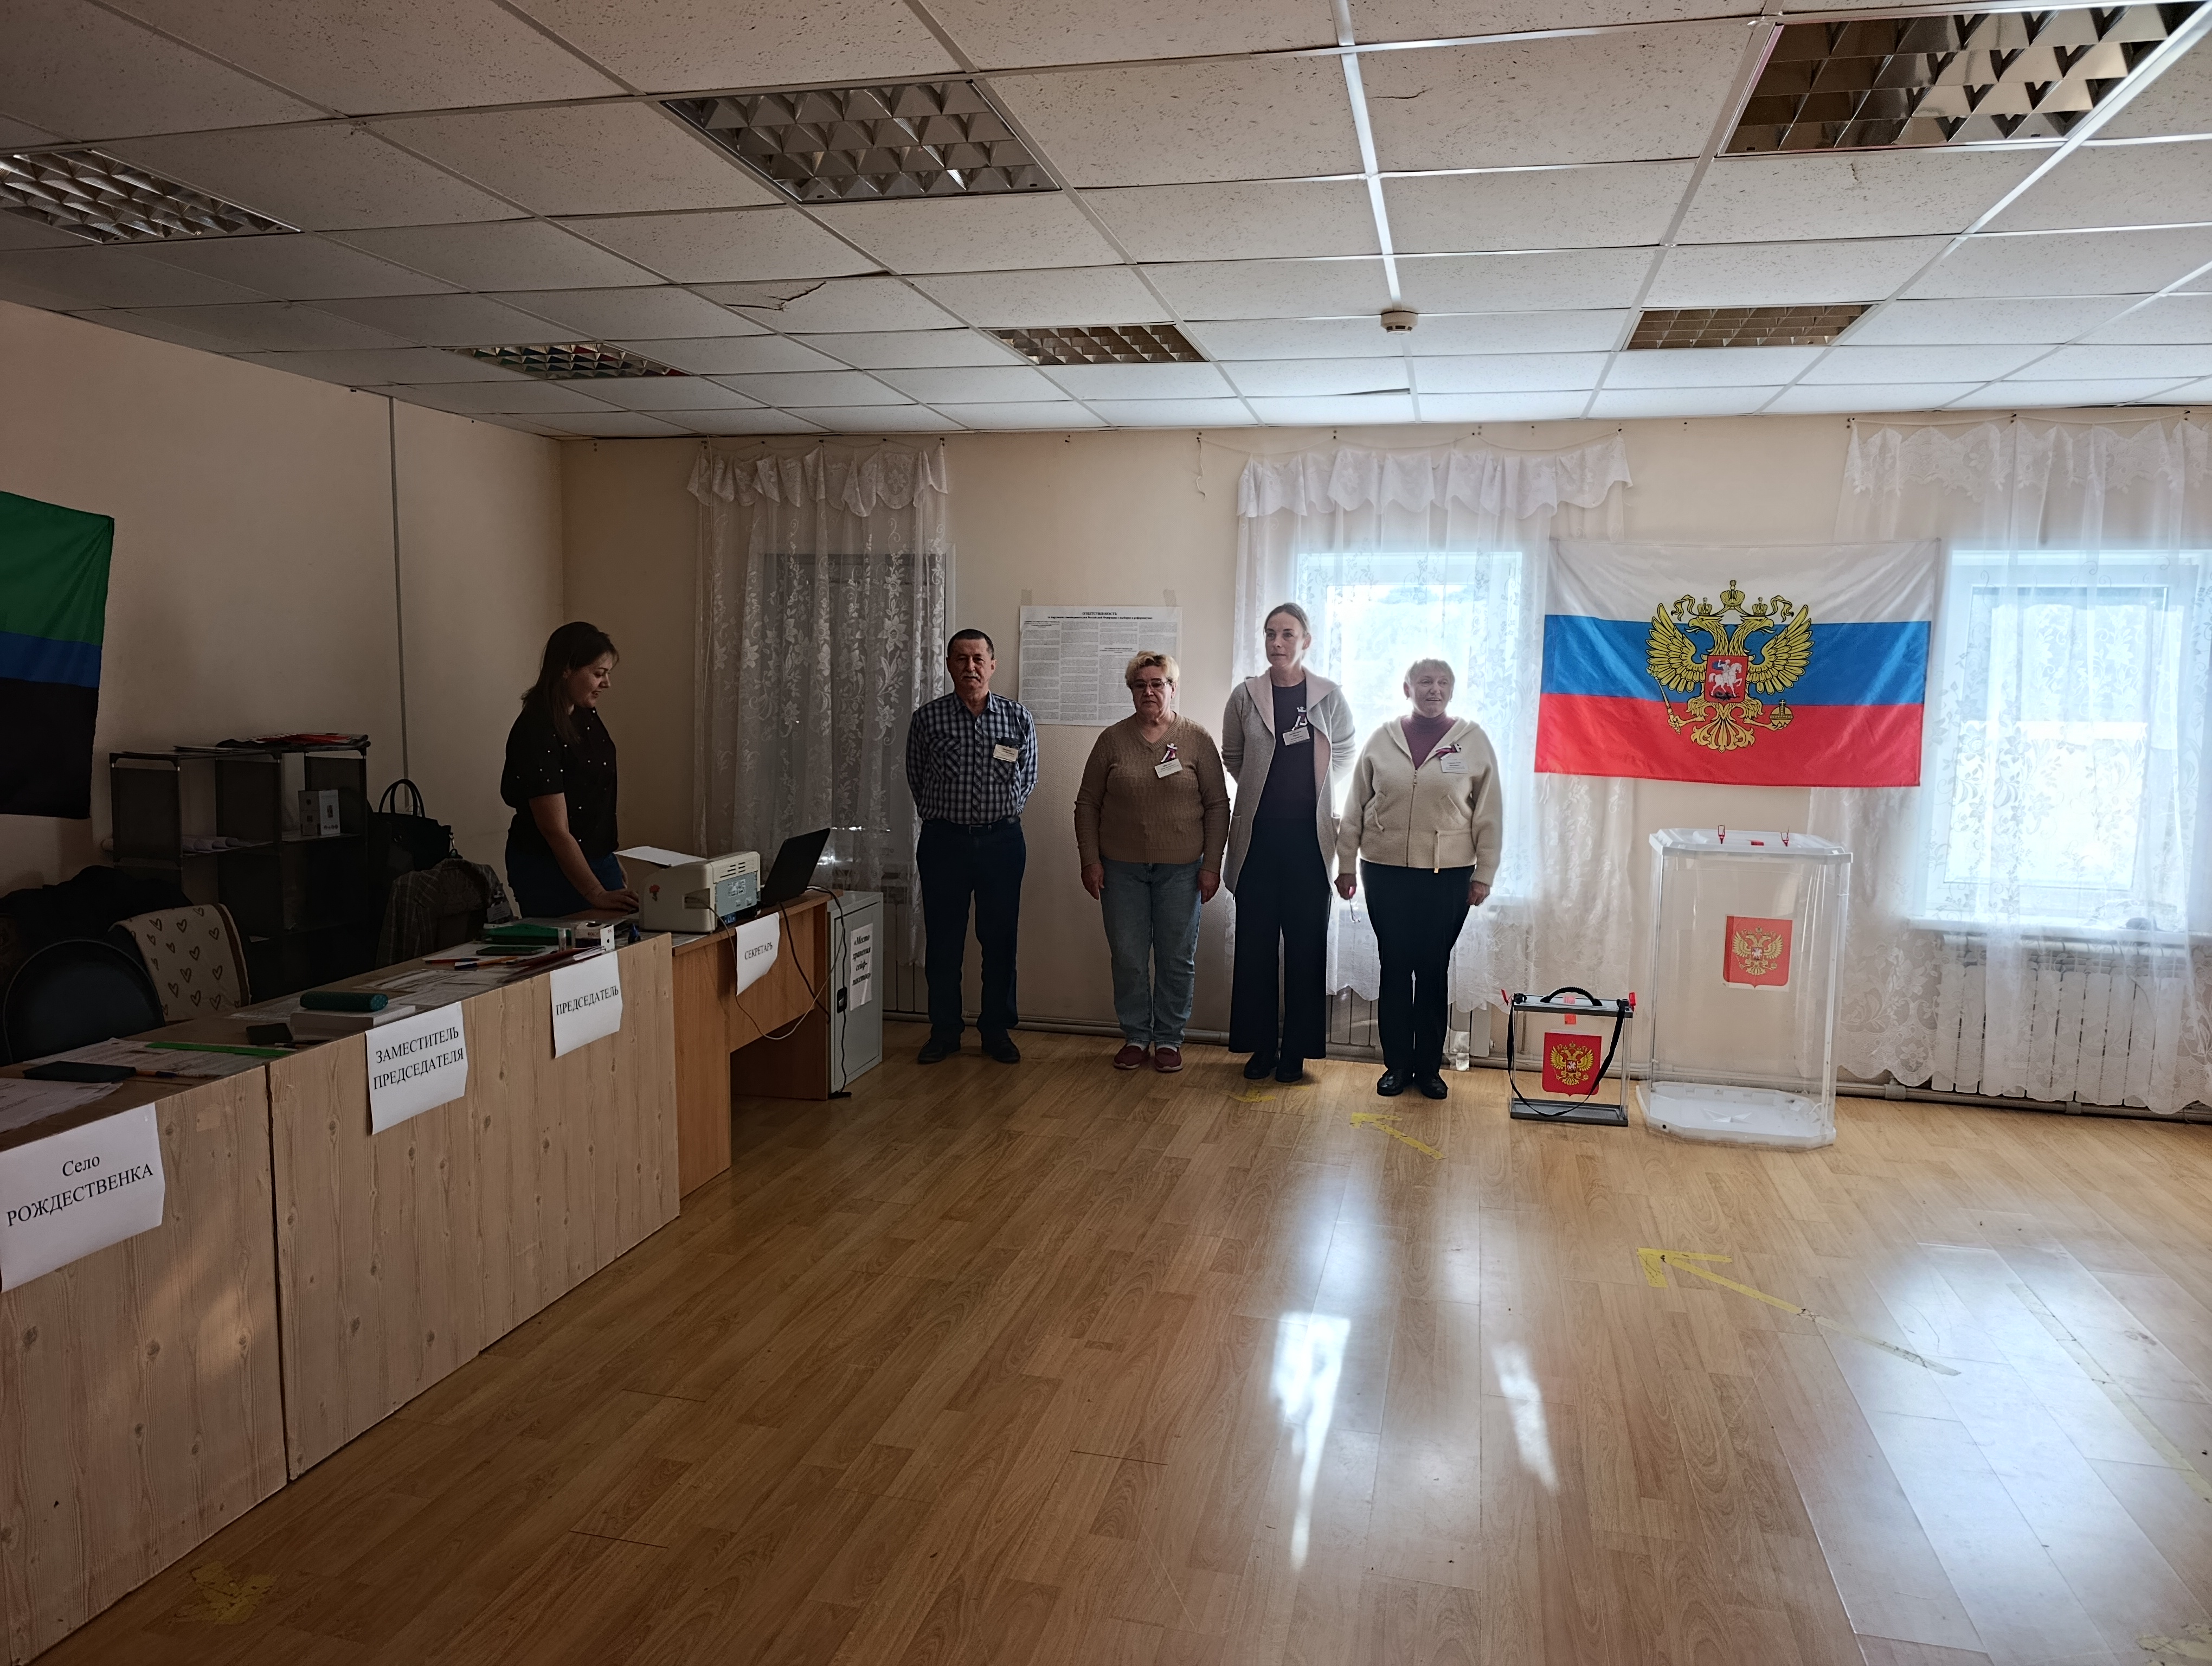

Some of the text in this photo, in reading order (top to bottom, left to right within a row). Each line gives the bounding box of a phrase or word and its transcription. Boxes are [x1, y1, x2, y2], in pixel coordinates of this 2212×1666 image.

[744, 942, 773, 960] СЕКРЕТАРЬ
[556, 985, 619, 1016] ПРЕДСЕДАТЕЛЬ
[376, 1027, 459, 1063] ЗАМЕСТИТЕЛЬ
[373, 1048, 464, 1090] ПРЕДСЕДАТЕЛЯ
[62, 1156, 100, 1176] Село
[6, 1163, 153, 1227] РОЖДЕСТВЕНКА
